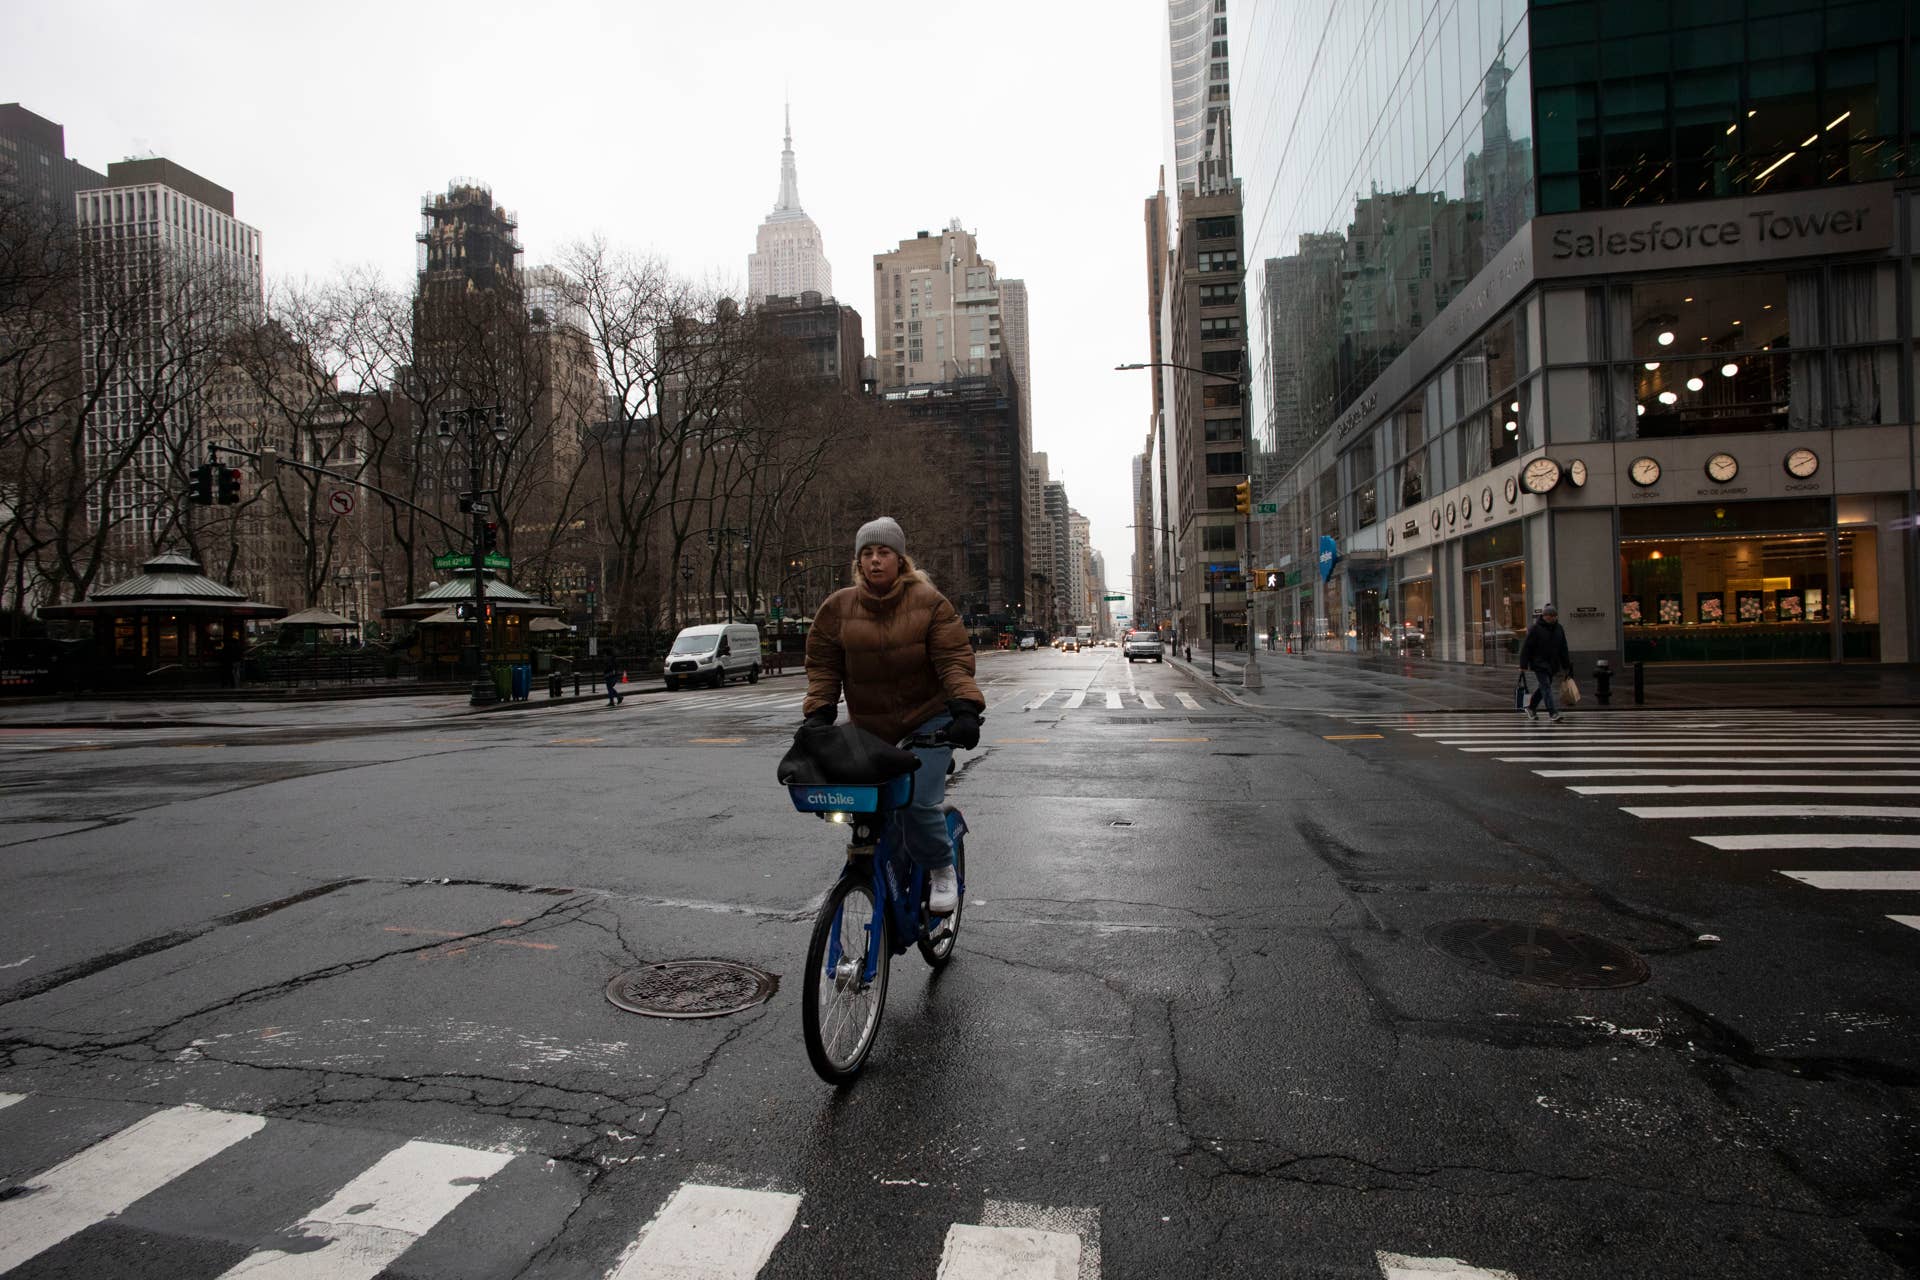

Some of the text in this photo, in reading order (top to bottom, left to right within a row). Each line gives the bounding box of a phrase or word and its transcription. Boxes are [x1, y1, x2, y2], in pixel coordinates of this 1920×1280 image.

[1552, 204, 1870, 259] Salesforce Tower
[1785, 484, 1820, 492] CHICAGO
[829, 792, 855, 805] bike
